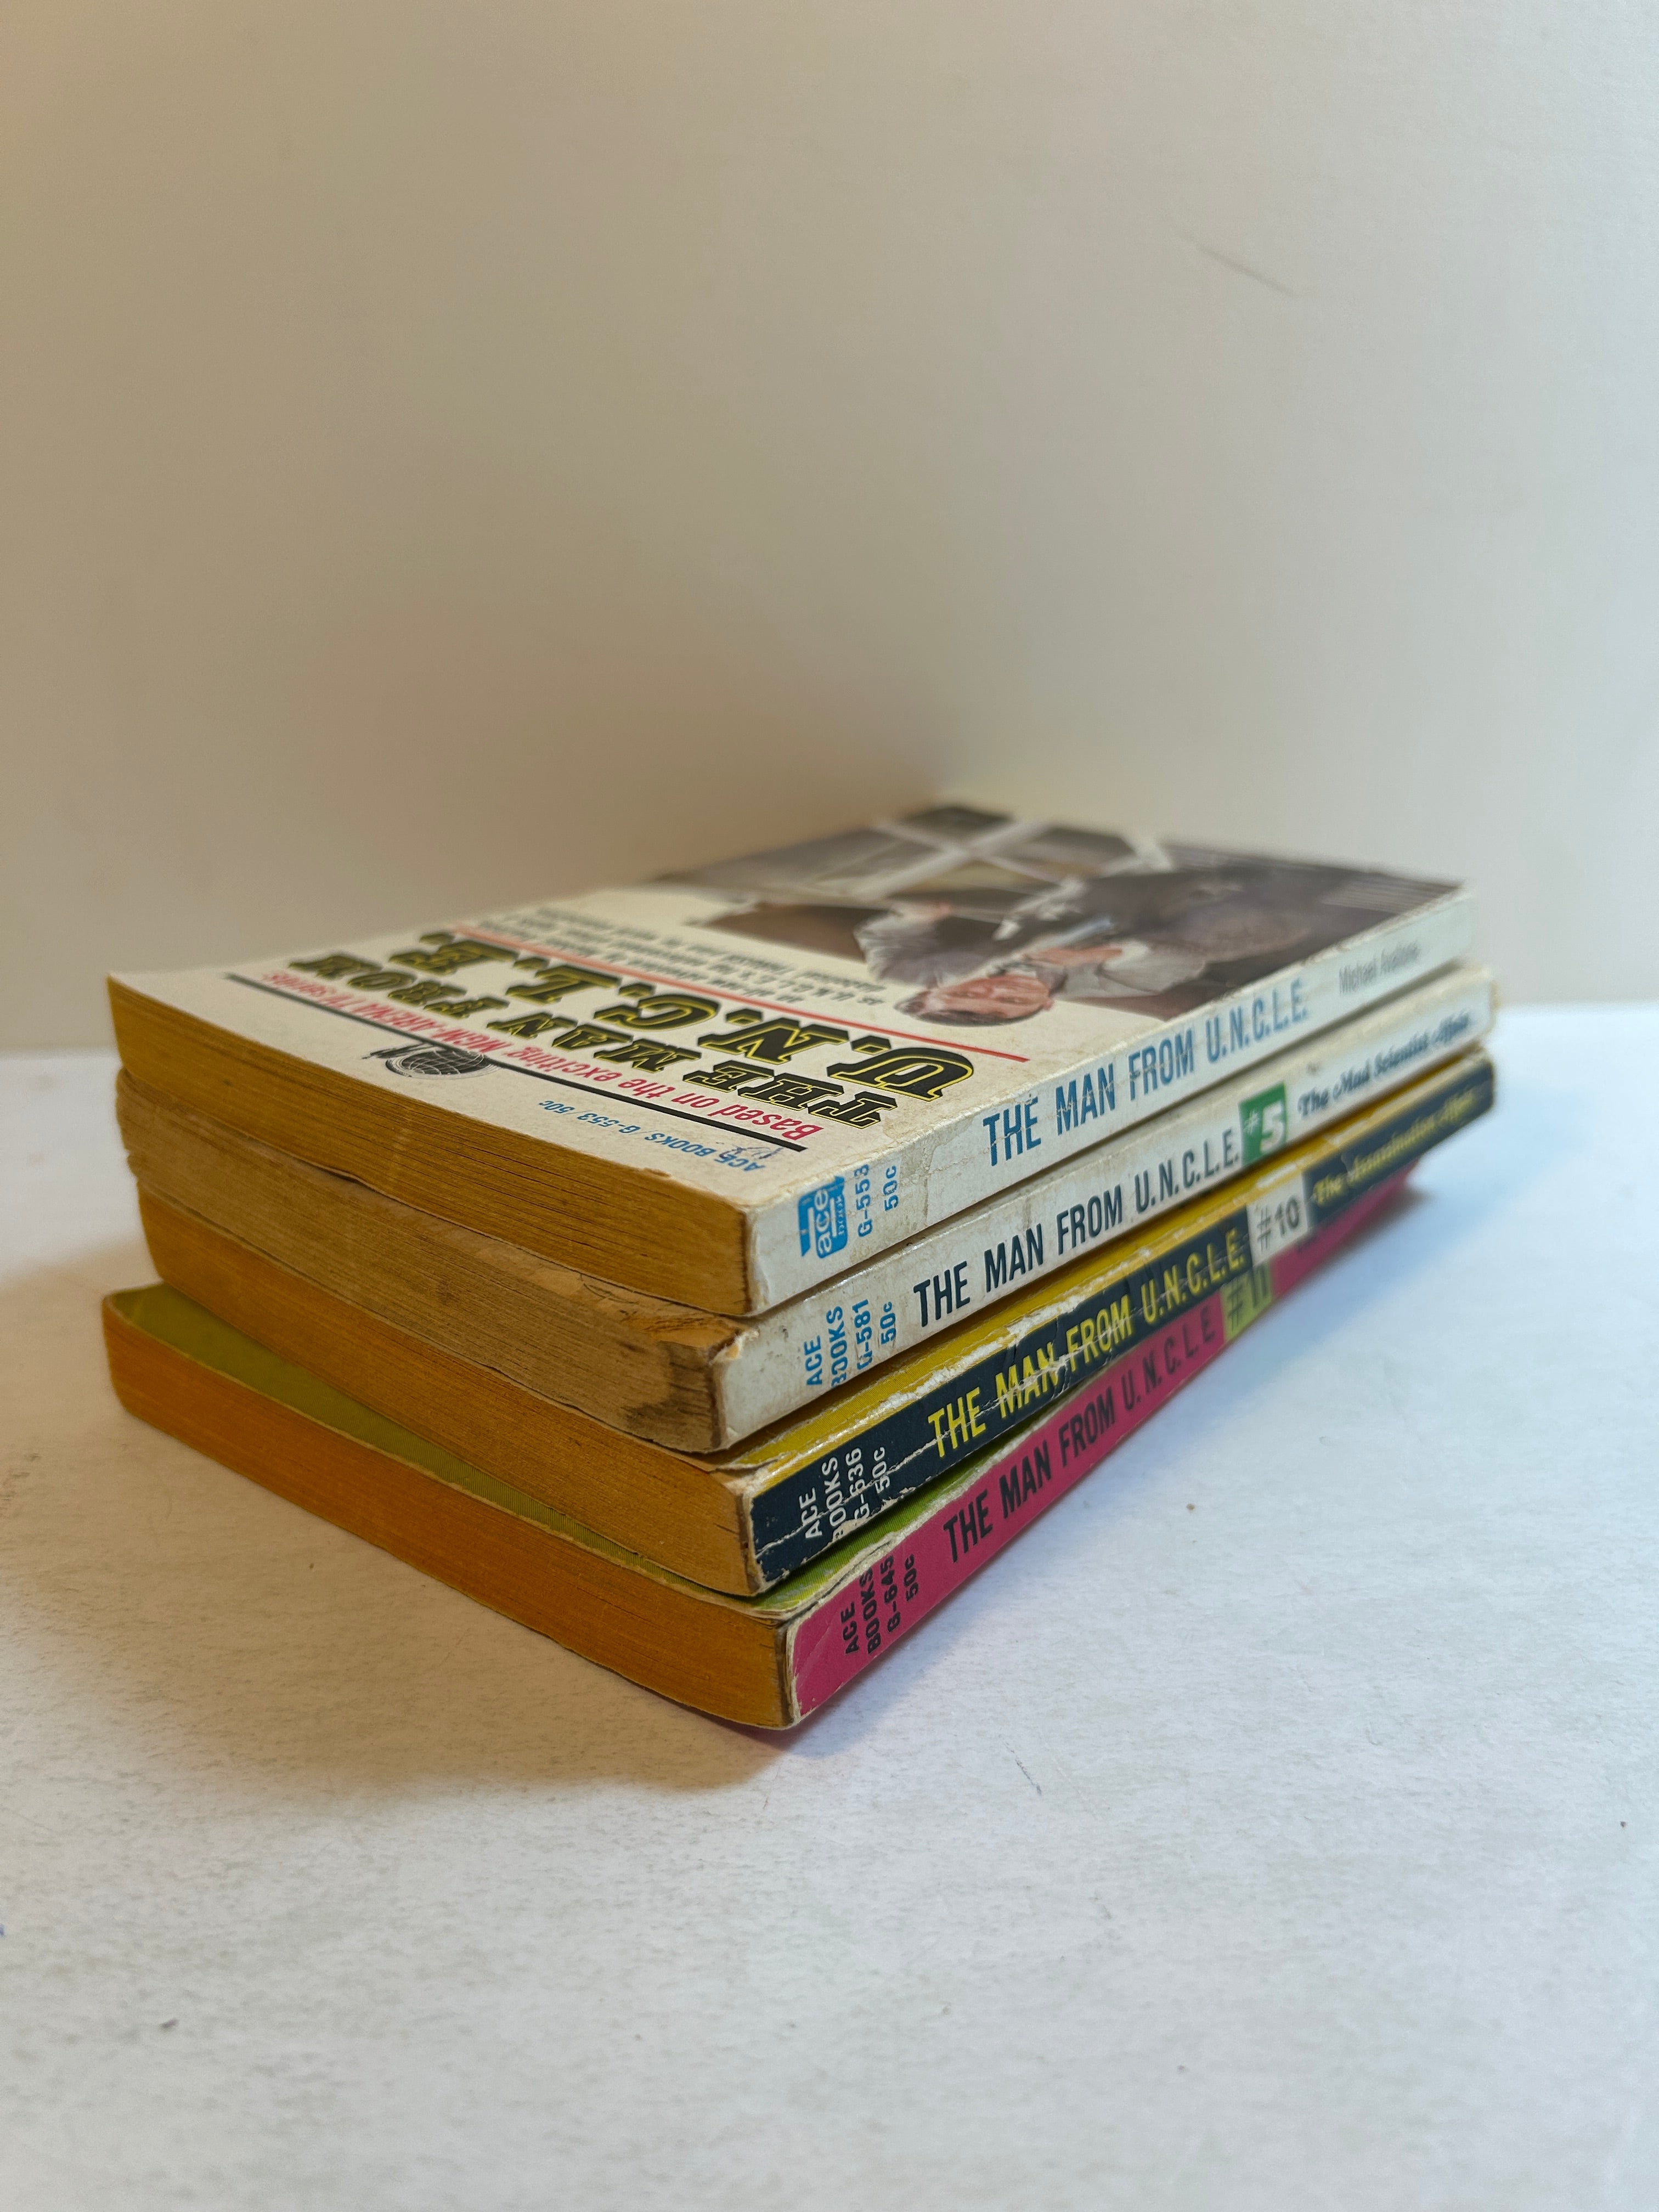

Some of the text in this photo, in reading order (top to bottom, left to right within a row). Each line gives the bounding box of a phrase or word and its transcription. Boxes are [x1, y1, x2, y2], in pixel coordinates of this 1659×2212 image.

[289, 953, 898, 1129] THE MAN FROM
[389, 932, 974, 1102] U.N.C.L.E.
[508, 1046, 622, 1082] exciting
[618, 1077, 675, 1098] the
[983, 979, 1308, 1166] THE MAN FROM U.N.C.L.E.
[1297, 1086, 1329, 1117] The
[1333, 1058, 1370, 1102] Mad
[539, 1101, 575, 1114] 50c
[577, 1113, 641, 1134] G-553
[671, 1092, 719, 1108] on
[707, 1104, 823, 1141] Based
[645, 1132, 716, 1157] BOOKS
[1243, 1101, 1285, 1153] #5
[714, 1154, 765, 1171] ACE
[883, 1165, 899, 1211] 50c
[814, 1189, 832, 1255] ace
[854, 1164, 873, 1237] G-553
[1256, 1196, 1300, 1251] #10
[913, 1128, 1239, 1327] THE MAN FROM U.N.C.L.E.
[826, 1306, 848, 1387] BOOKS
[852, 1299, 872, 1370] G-581
[880, 1301, 896, 1345] 50c
[928, 1228, 1246, 1458] THE MAN FROM U.N.C.L.E.
[804, 1335, 822, 1386] ACE
[845, 1447, 870, 1521] G-636
[872, 1447, 890, 1494] 50c
[943, 1488, 993, 1563] THE
[999, 1440, 1052, 1519] MAN
[1058, 1386, 1115, 1468] FROM
[799, 1487, 822, 1538] ACE
[880, 1555, 901, 1633] G-645
[904, 1554, 919, 1601] 50c
[840, 1602, 859, 1654] ACE
[859, 1567, 881, 1654] BOOKS
